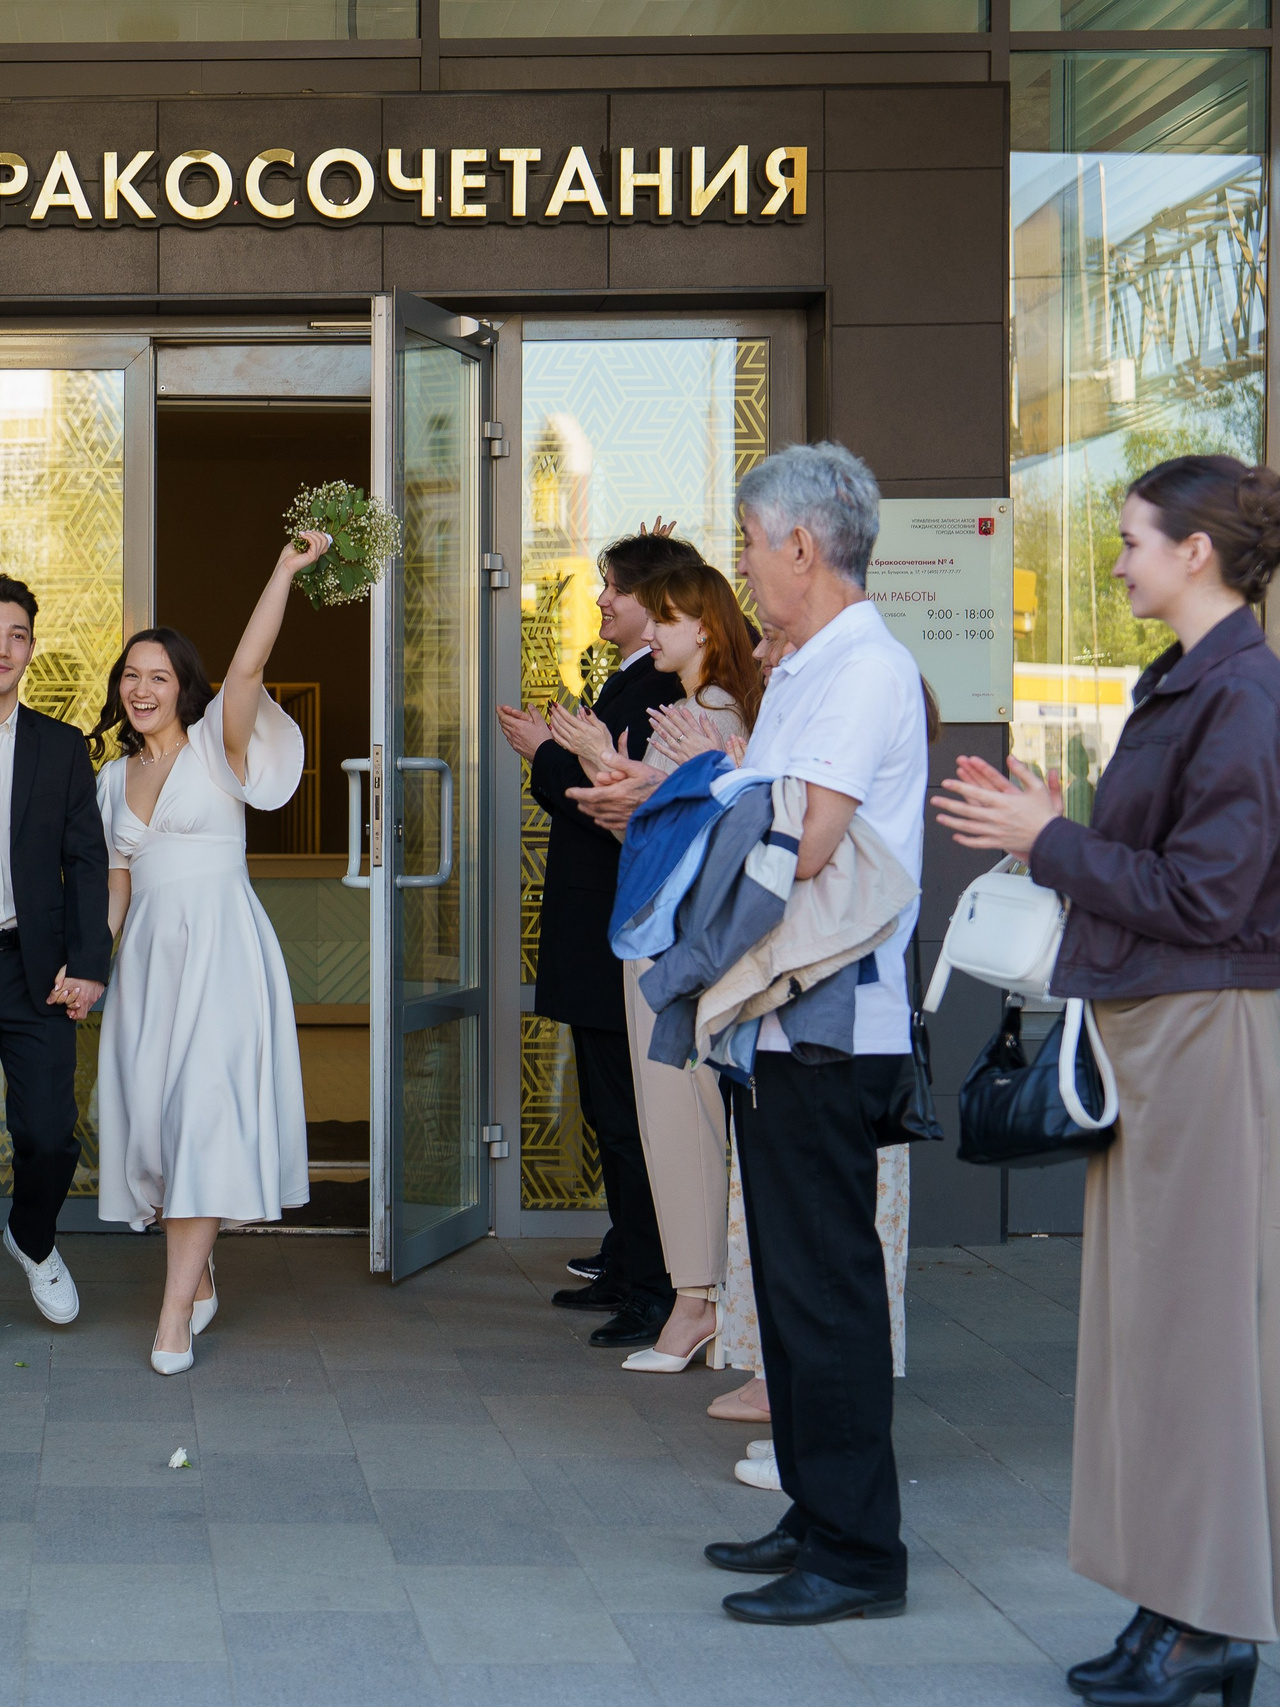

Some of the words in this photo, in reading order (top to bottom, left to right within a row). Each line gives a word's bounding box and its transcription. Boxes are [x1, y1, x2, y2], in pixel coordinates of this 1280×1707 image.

[874, 558, 936, 567] бракосочетания
[891, 592, 936, 602] РАБОТЫ
[927, 609, 952, 619] 9:00
[965, 609, 994, 619] 18:00
[922, 630, 952, 640] 10:00
[965, 630, 994, 640] 19:00
